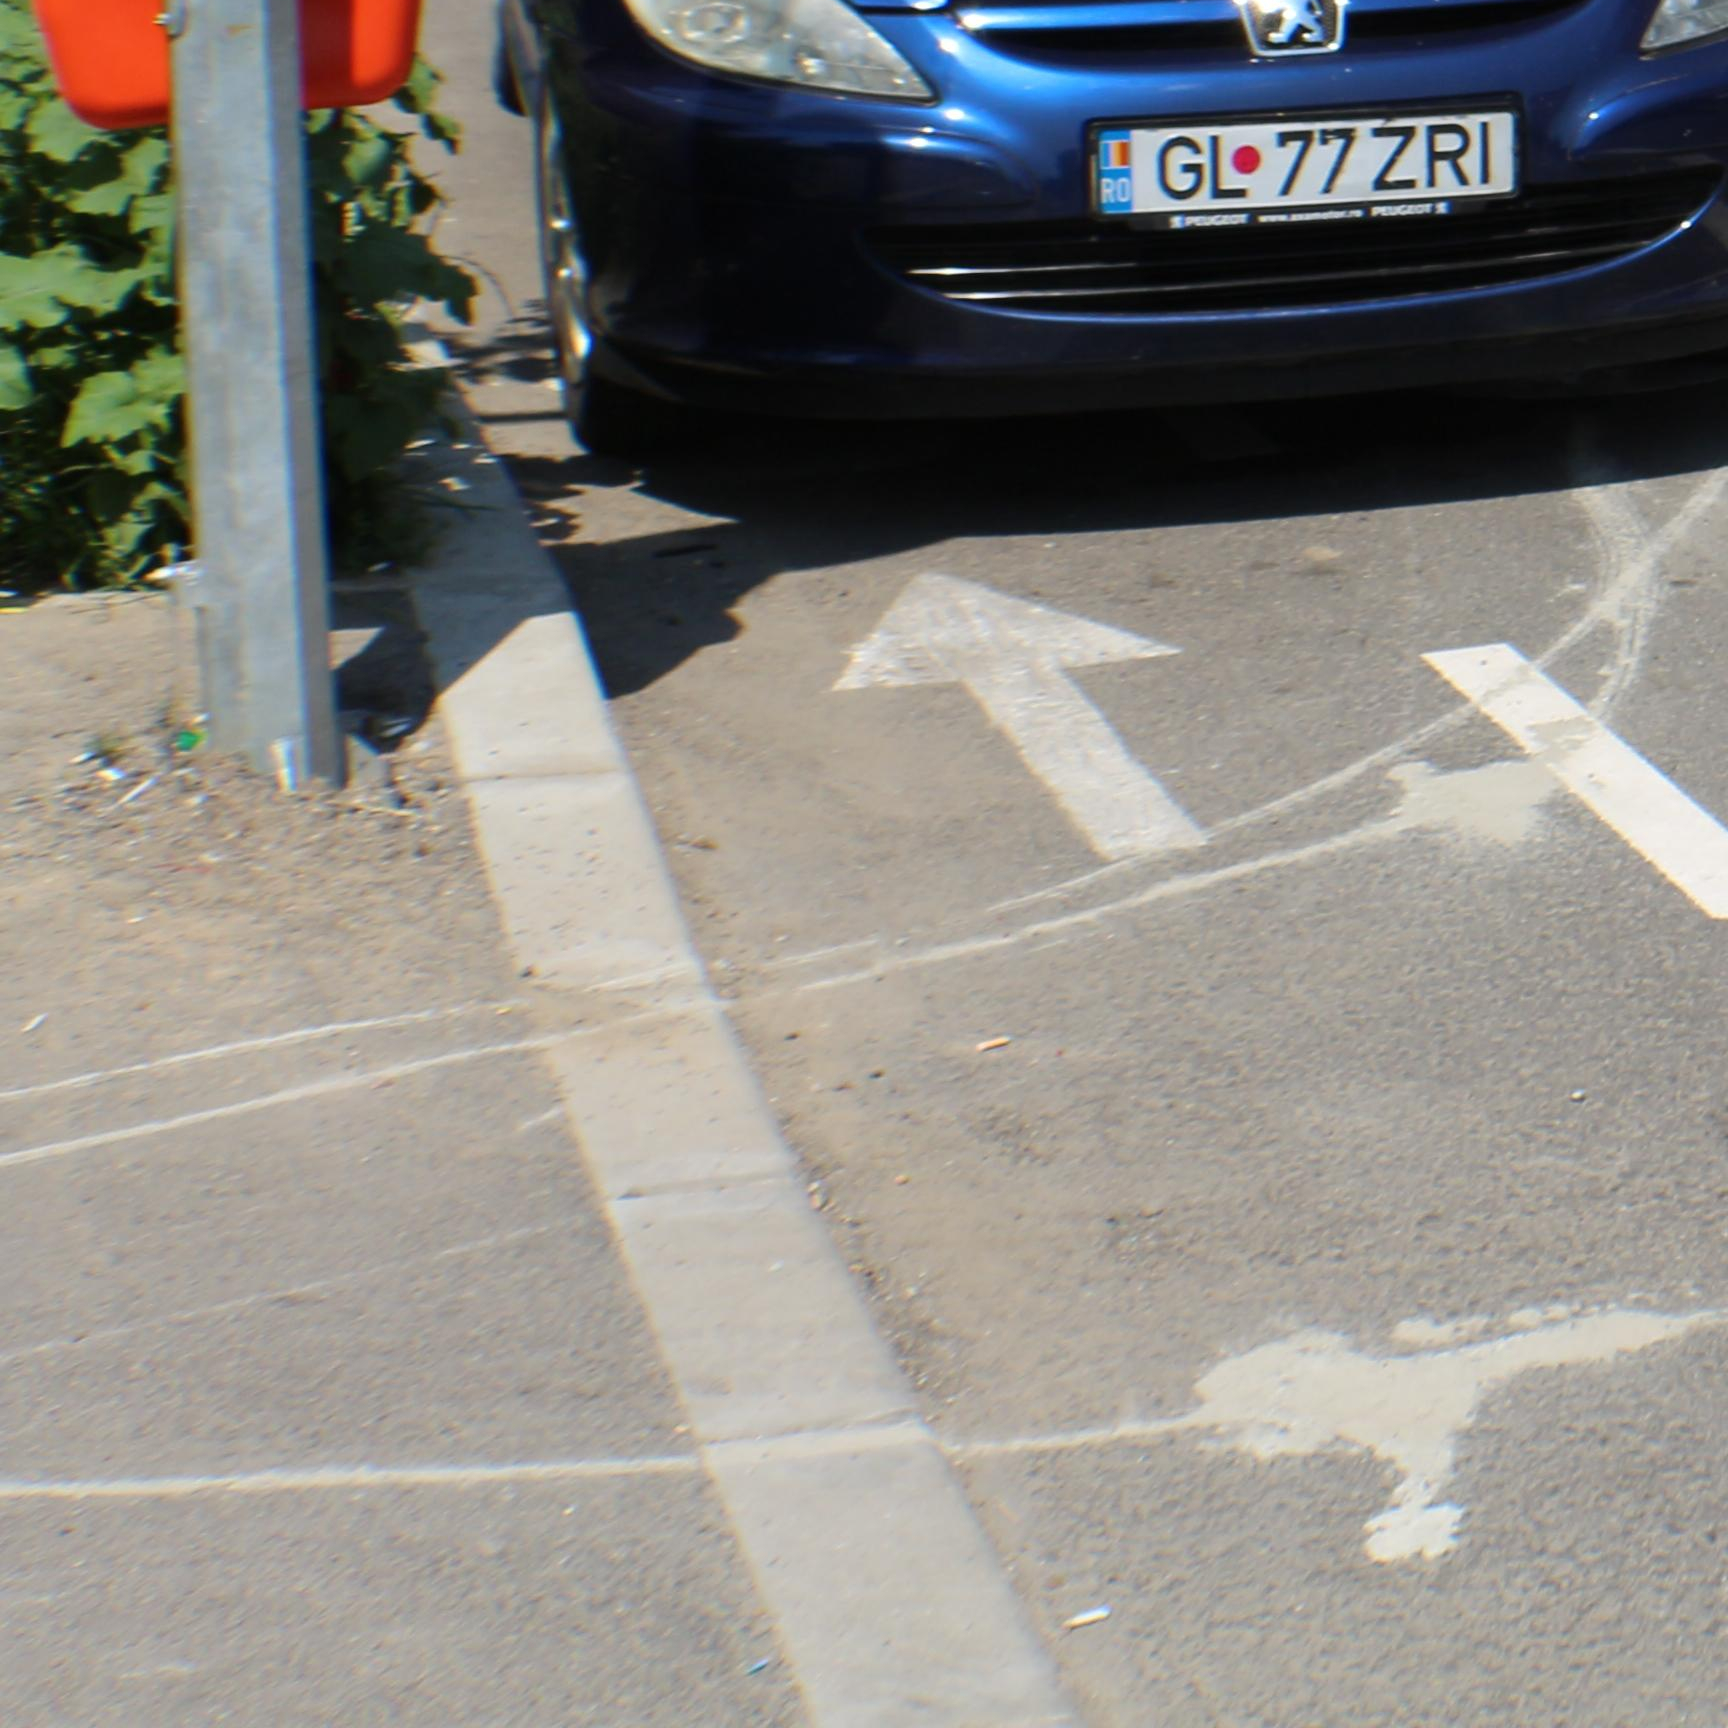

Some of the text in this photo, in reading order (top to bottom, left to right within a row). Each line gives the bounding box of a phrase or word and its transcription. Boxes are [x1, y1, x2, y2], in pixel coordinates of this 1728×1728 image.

[1159, 122, 1490, 200] GL 77 ZRI
[1101, 177, 1130, 203] RO
[1184, 214, 1247, 227] PEUGEOT
[1371, 203, 1435, 217] PEUGEOT
